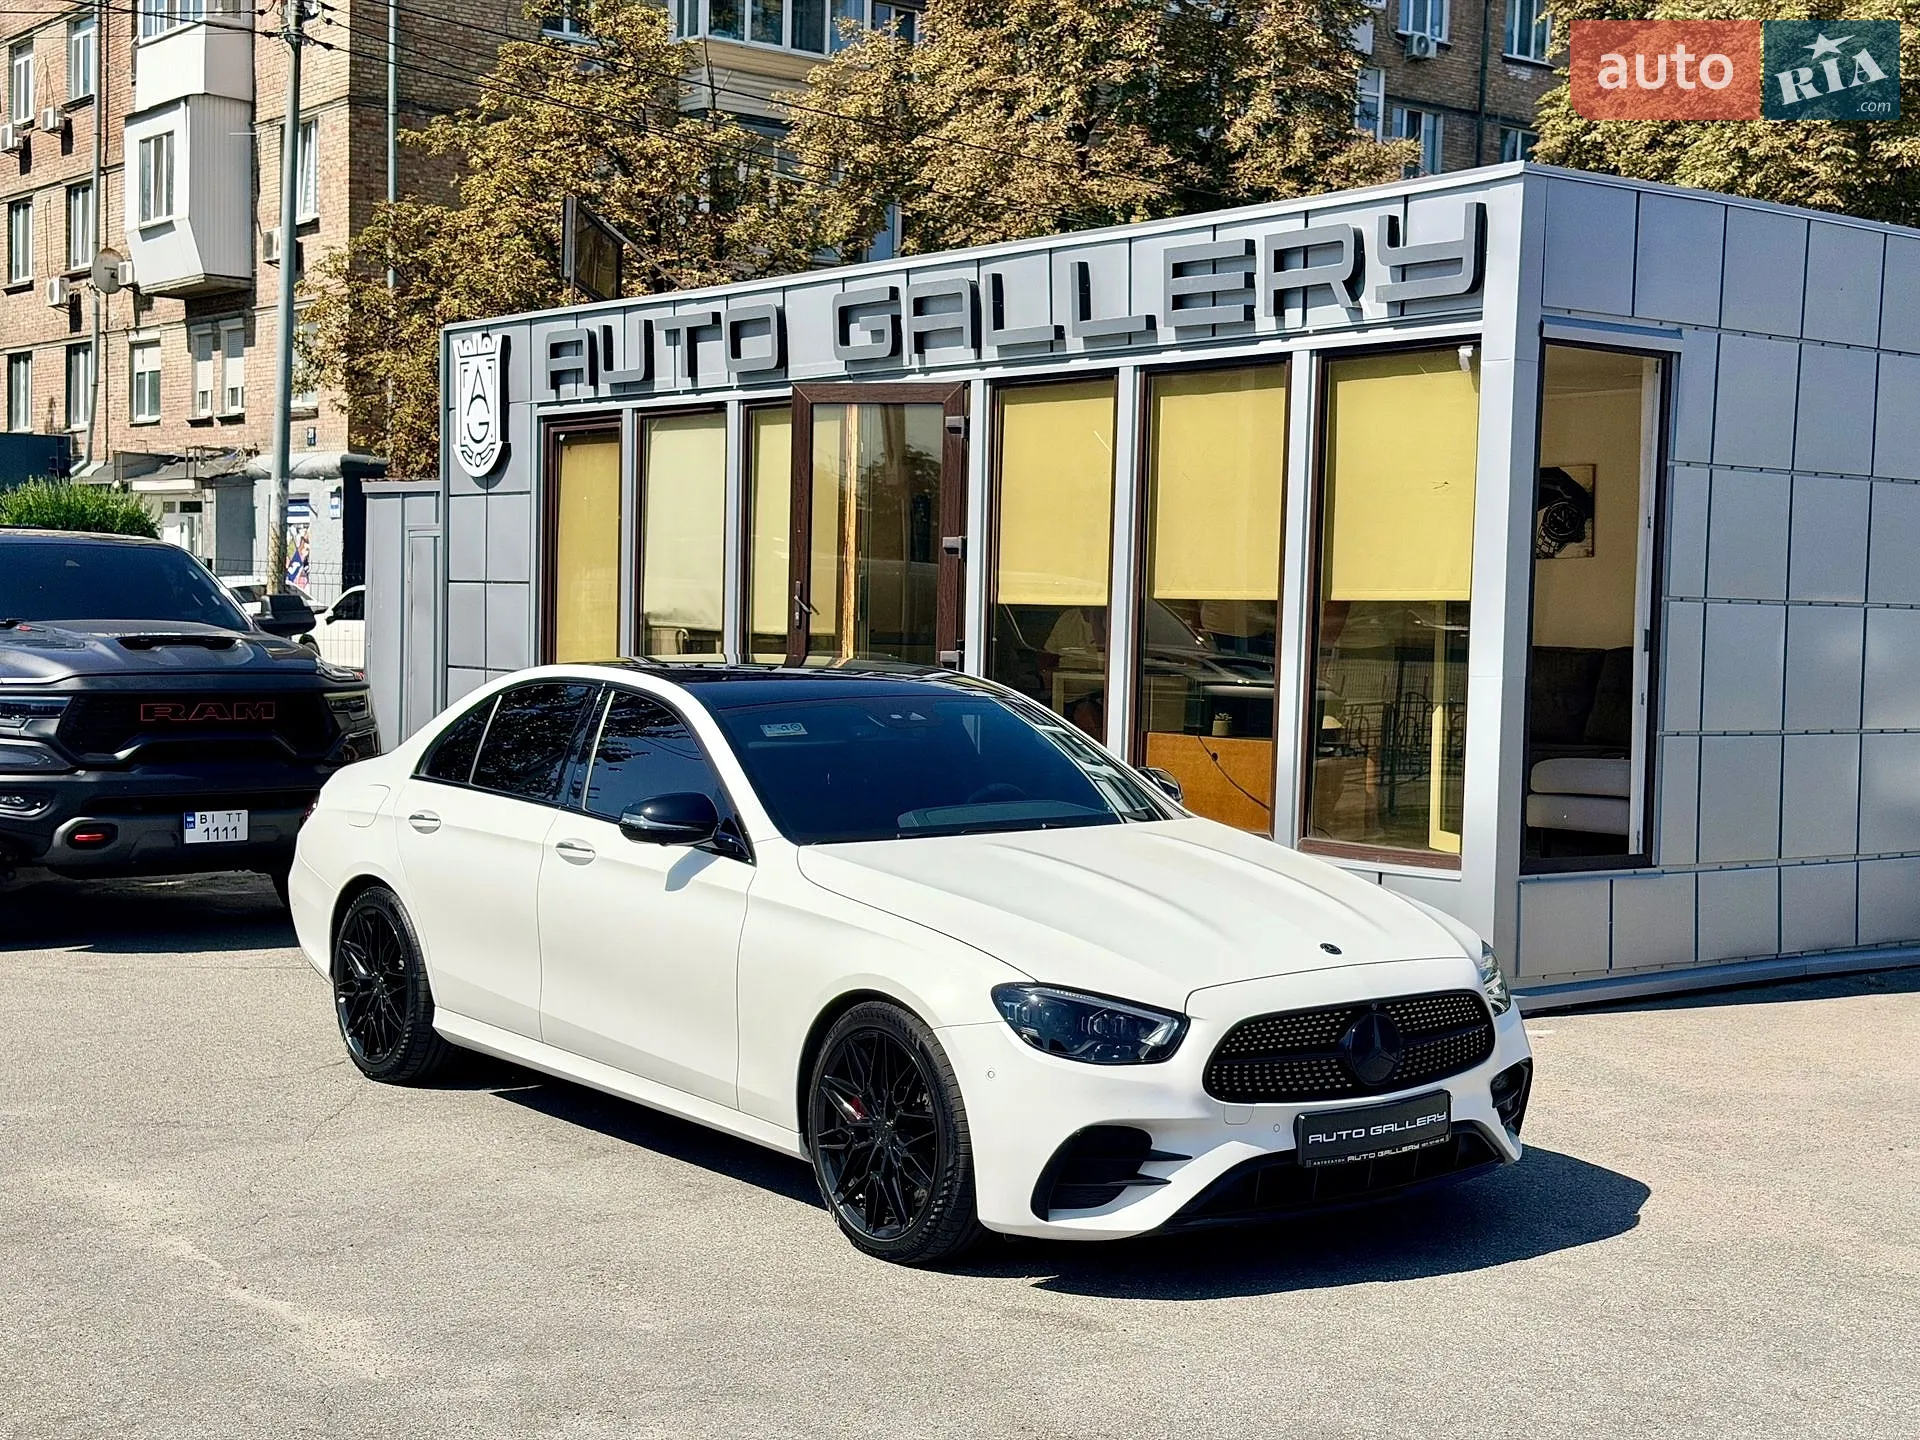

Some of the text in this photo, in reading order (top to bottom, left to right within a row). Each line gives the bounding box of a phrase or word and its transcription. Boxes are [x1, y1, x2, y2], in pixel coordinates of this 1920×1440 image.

[544, 201, 1487, 391] AUTO GALLERY
[140, 701, 276, 722] RAM
[203, 826, 237, 840] 1111
[1308, 1111, 1447, 1144] AUTO GALLERY
[1347, 1144, 1420, 1162] AUTO GALLERY
